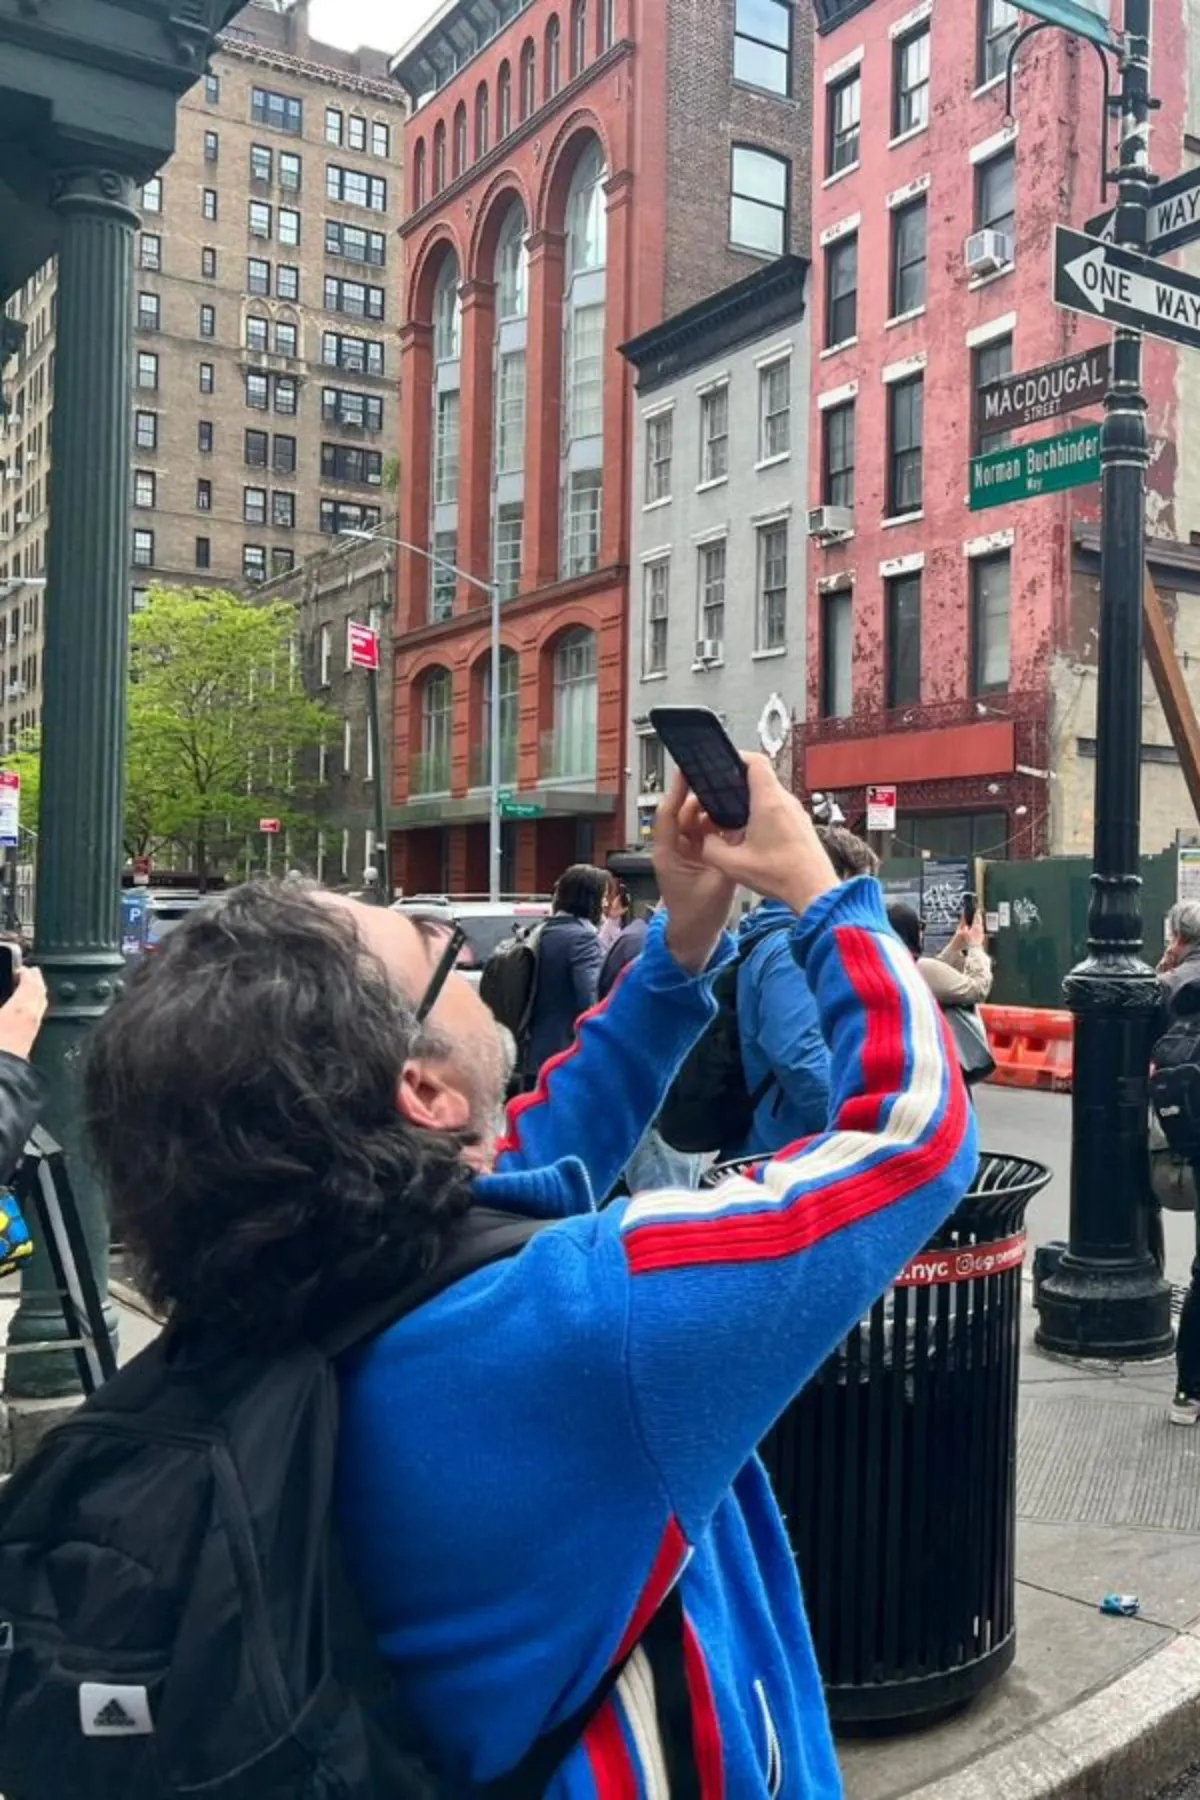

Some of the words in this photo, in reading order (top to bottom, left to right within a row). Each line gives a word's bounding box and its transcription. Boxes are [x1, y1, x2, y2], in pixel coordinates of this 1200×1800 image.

[1157, 189, 1200, 234] WAY
[1082, 261, 1131, 303] ONE
[985, 358, 1103, 421] MACDOUGAL
[1023, 399, 1062, 423] STREET
[974, 458, 1021, 489] Norman
[1026, 435, 1099, 475] Buchbinder
[1026, 478, 1043, 492] Way
